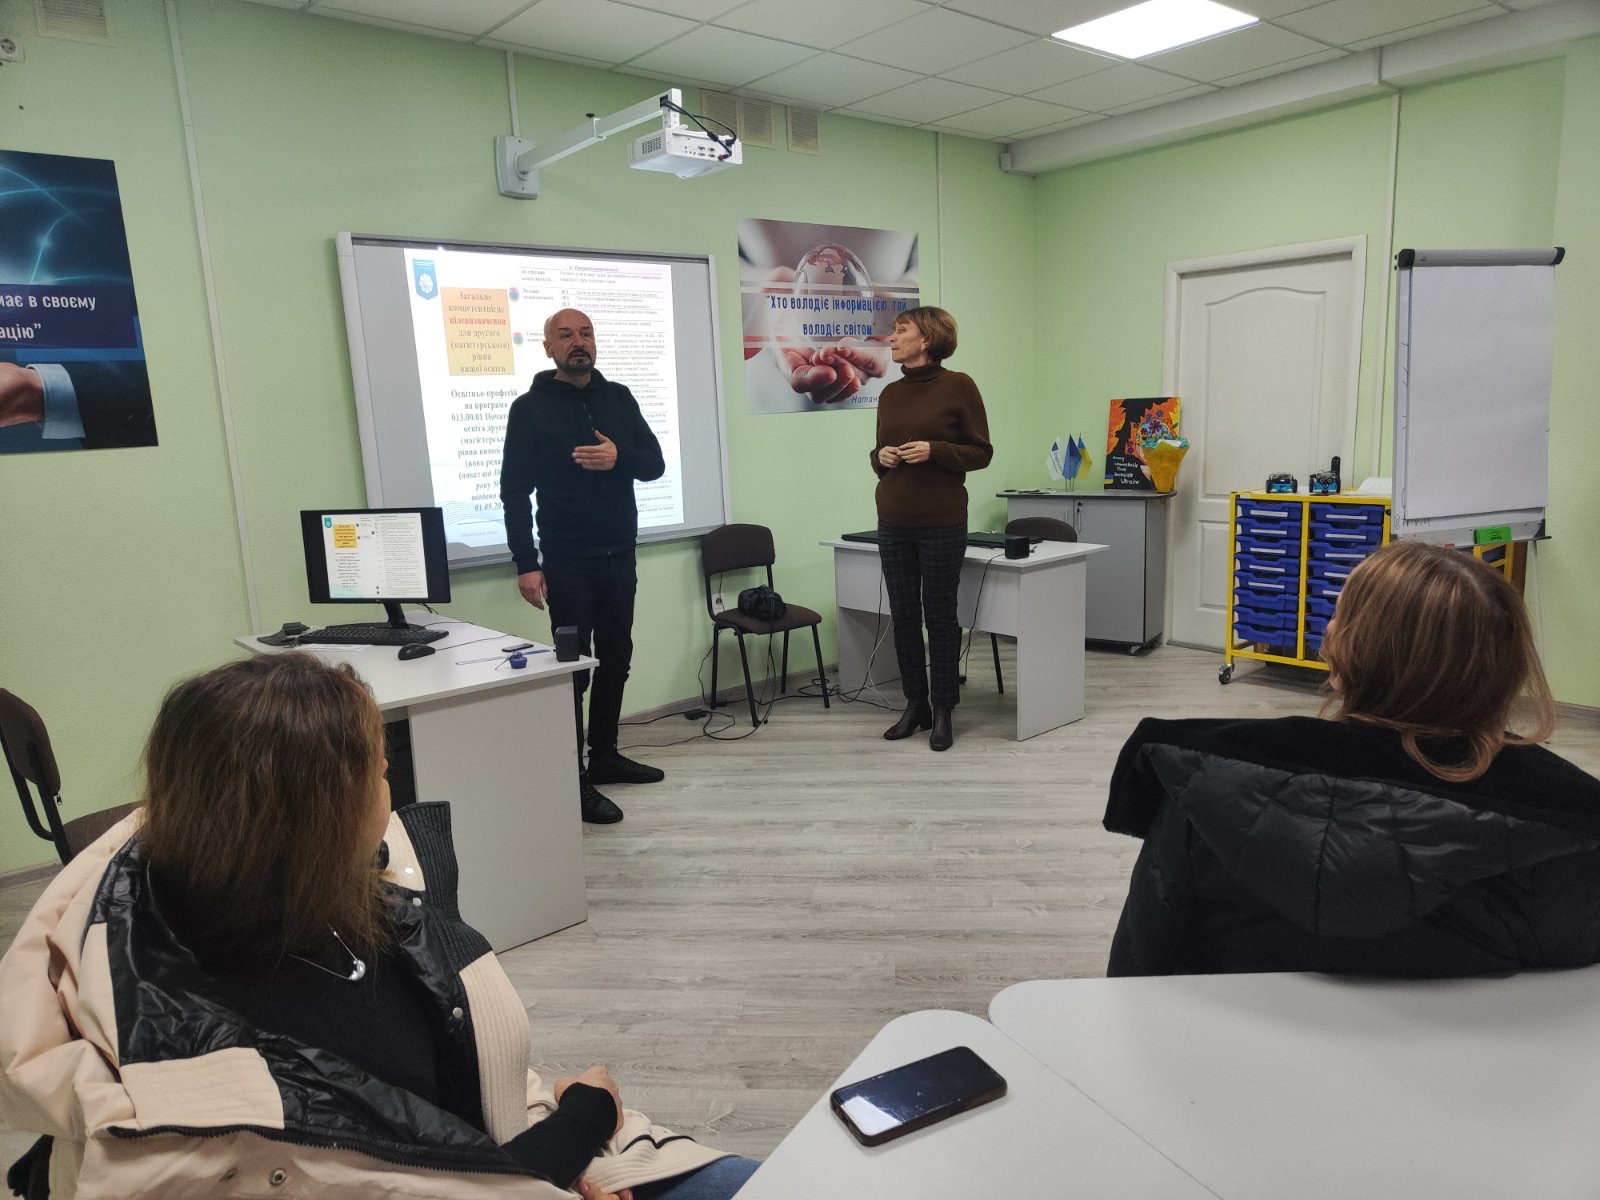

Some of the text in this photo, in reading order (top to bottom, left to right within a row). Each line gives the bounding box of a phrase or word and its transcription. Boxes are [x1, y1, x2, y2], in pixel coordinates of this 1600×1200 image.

[28, 296, 38, 308] в
[42, 296, 96, 311] своєму
[790, 296, 830, 313] володіє
[803, 322, 841, 337] володіє
[474, 402, 508, 411] програма
[485, 411, 509, 421] Почат
[487, 424, 507, 434] друго
[485, 459, 503, 468] реда
